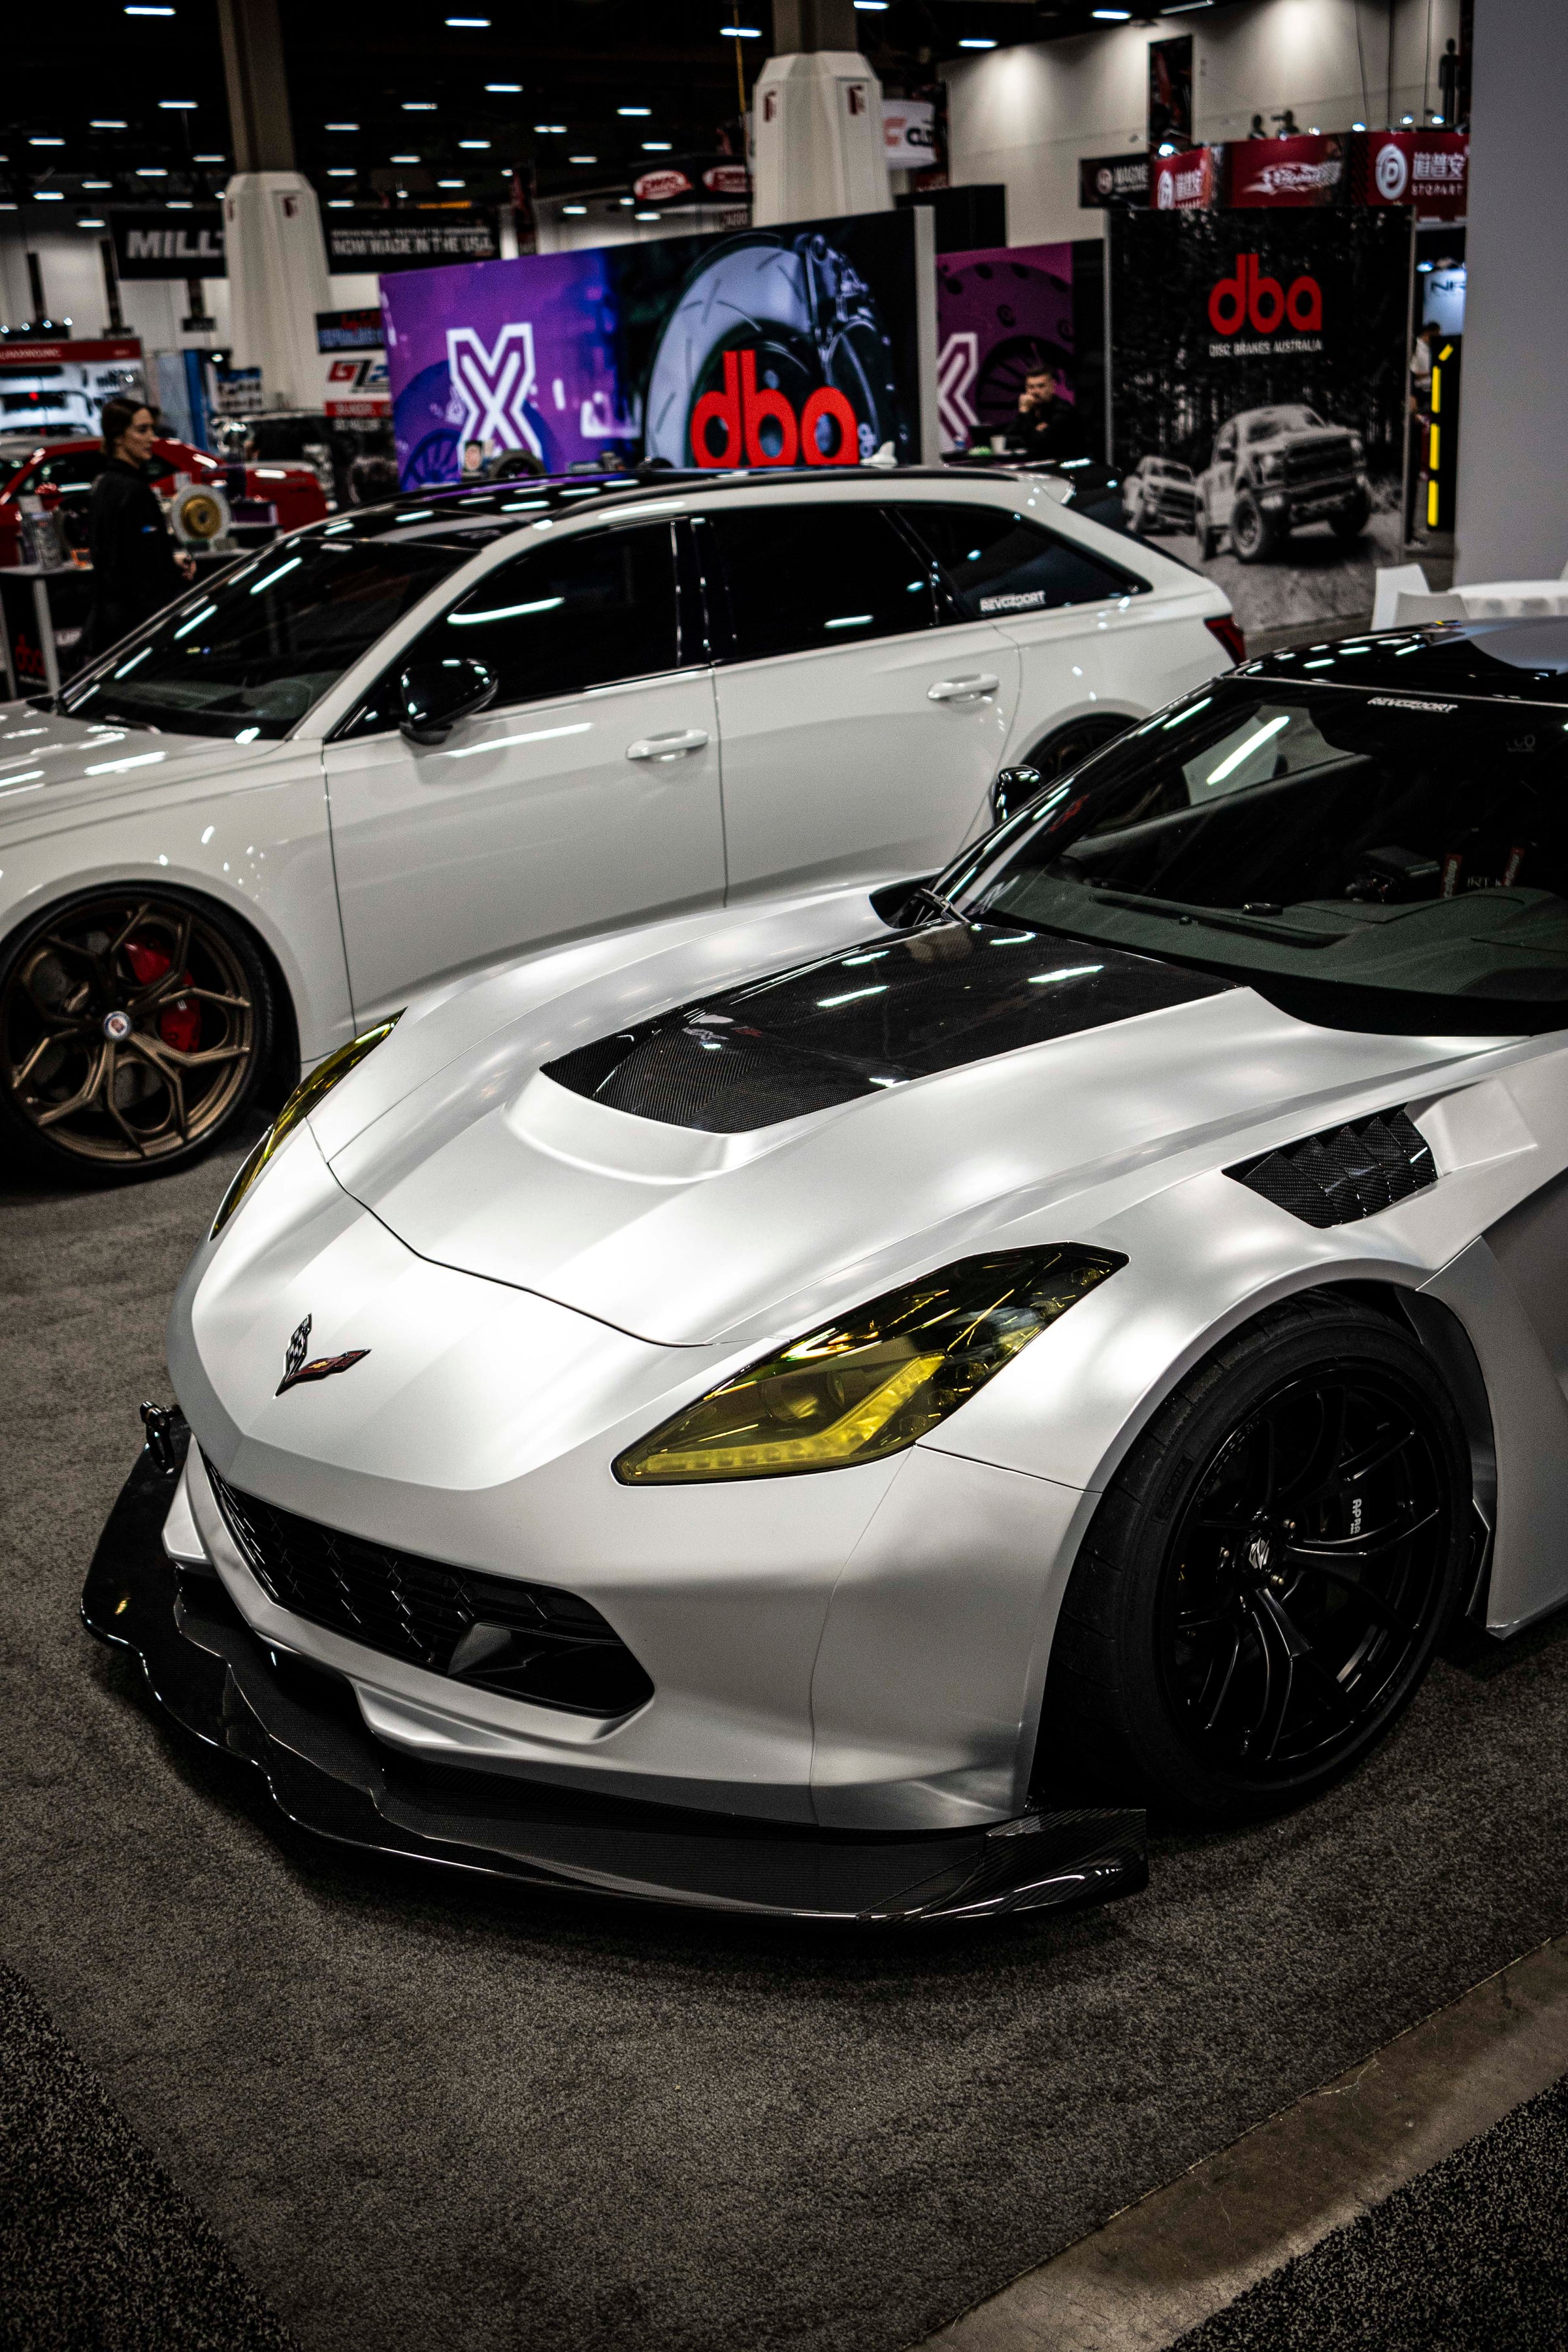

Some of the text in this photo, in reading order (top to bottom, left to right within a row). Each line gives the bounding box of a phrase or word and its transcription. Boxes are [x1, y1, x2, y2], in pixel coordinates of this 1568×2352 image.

[370, 237, 411, 255] MADE
[415, 237, 431, 253] IN
[431, 236, 459, 253] THE
[1207, 252, 1323, 336] dba
[1209, 337, 1322, 357] DISC BRAKES AUSTRALIA
[691, 349, 860, 468] dba
